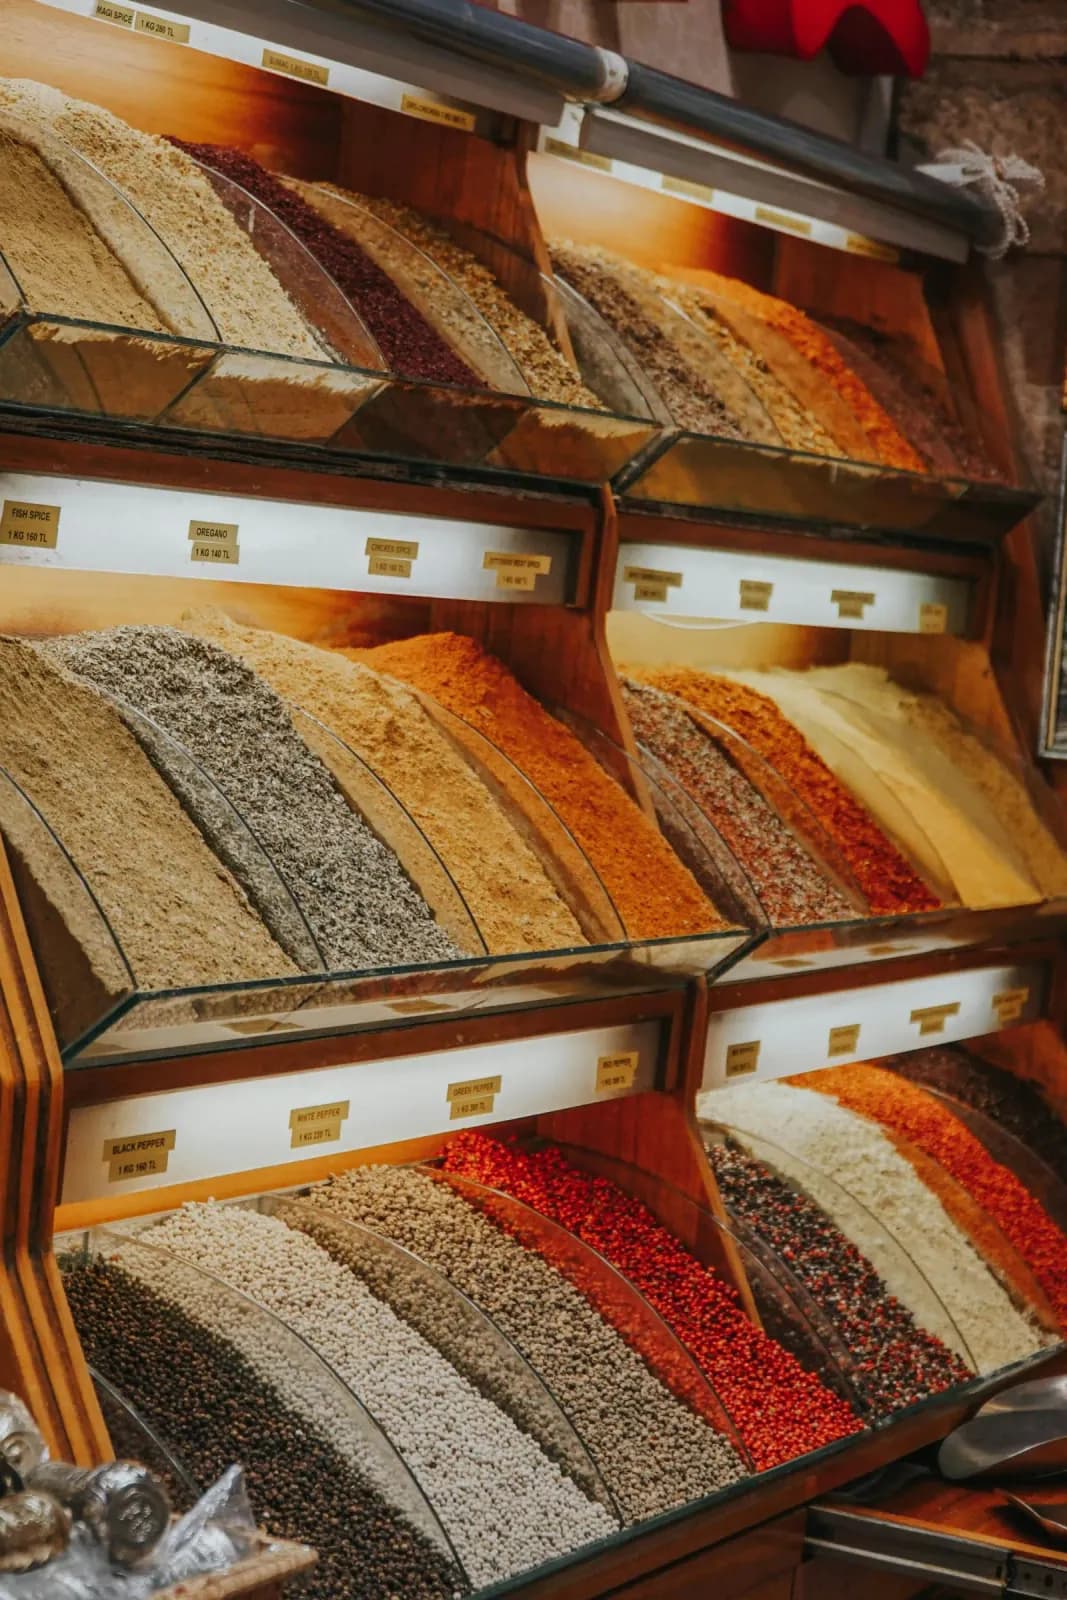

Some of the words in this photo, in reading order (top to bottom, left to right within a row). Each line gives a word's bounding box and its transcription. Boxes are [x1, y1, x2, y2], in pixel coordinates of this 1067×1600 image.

[113, 11, 133, 24] SPICE
[145, 21, 155, 31] KG
[167, 26, 175, 37] TL
[12, 508, 28, 519] FISH
[29, 510, 51, 521] SPICE
[13, 531, 25, 541] KG
[26, 532, 38, 542] 160
[39, 533, 48, 543] TL
[196, 527, 228, 538] OREGANO
[199, 548, 210, 557] KG
[211, 549, 222, 558] 140
[223, 550, 231, 559] TL
[472, 1082, 494, 1093] PEPPER
[316, 1107, 341, 1119] PEPPER
[303, 1132, 313, 1141] KG
[324, 1128, 332, 1137] TL
[112, 1143, 136, 1155] BLACK
[137, 1137, 166, 1150] PEPPER
[122, 1164, 135, 1174] KG
[148, 1159, 157, 1170] TL
